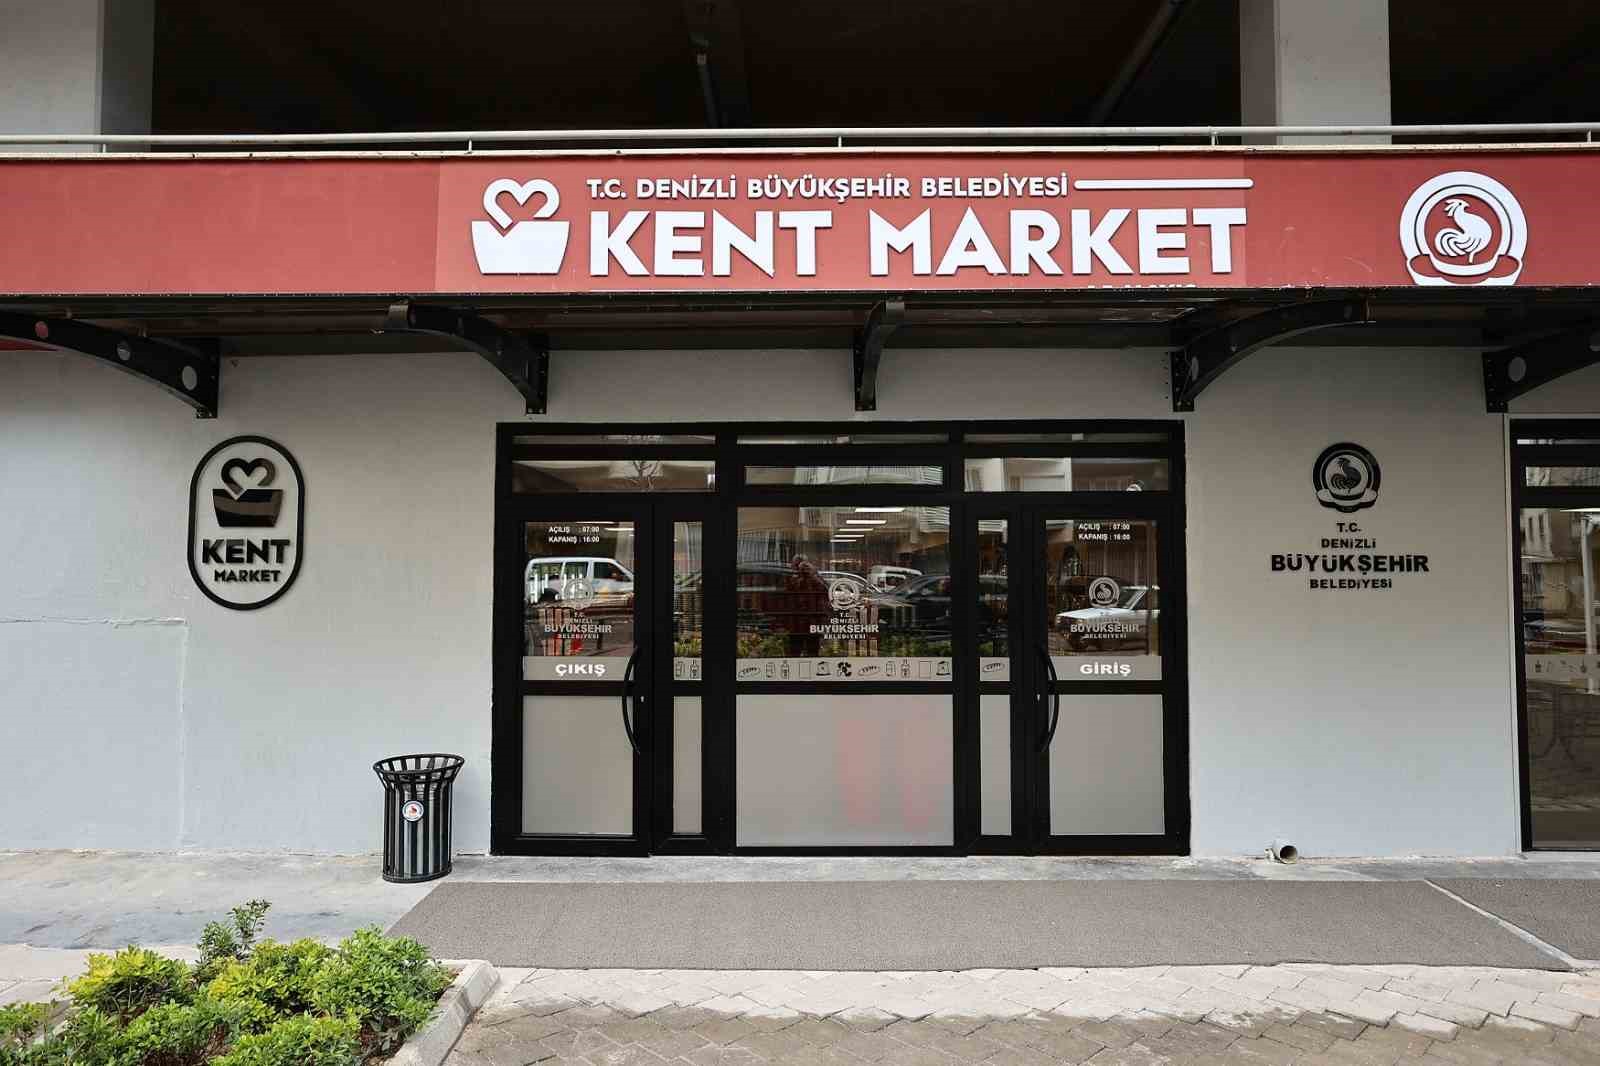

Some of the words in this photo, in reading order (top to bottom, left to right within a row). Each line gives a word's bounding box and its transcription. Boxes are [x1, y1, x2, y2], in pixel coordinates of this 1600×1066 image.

[586, 178, 626, 199] T.C.
[637, 174, 737, 199] DENİZLİ
[748, 173, 911, 203] BÜYÜKŞEHİR
[921, 172, 1068, 197] BELEDİYESİ
[590, 208, 833, 278] KENT
[869, 206, 1248, 277] MARKET
[1336, 522, 1361, 533] T.C.
[201, 538, 290, 564] KENT
[1321, 537, 1376, 549] DENİZLİ
[1271, 554, 1430, 575] BÜYÜKŞEHİR
[214, 569, 281, 582] MARKET
[555, 663, 606, 677] ÇIKIŞ
[1079, 661, 1132, 677] GİRİŞ
